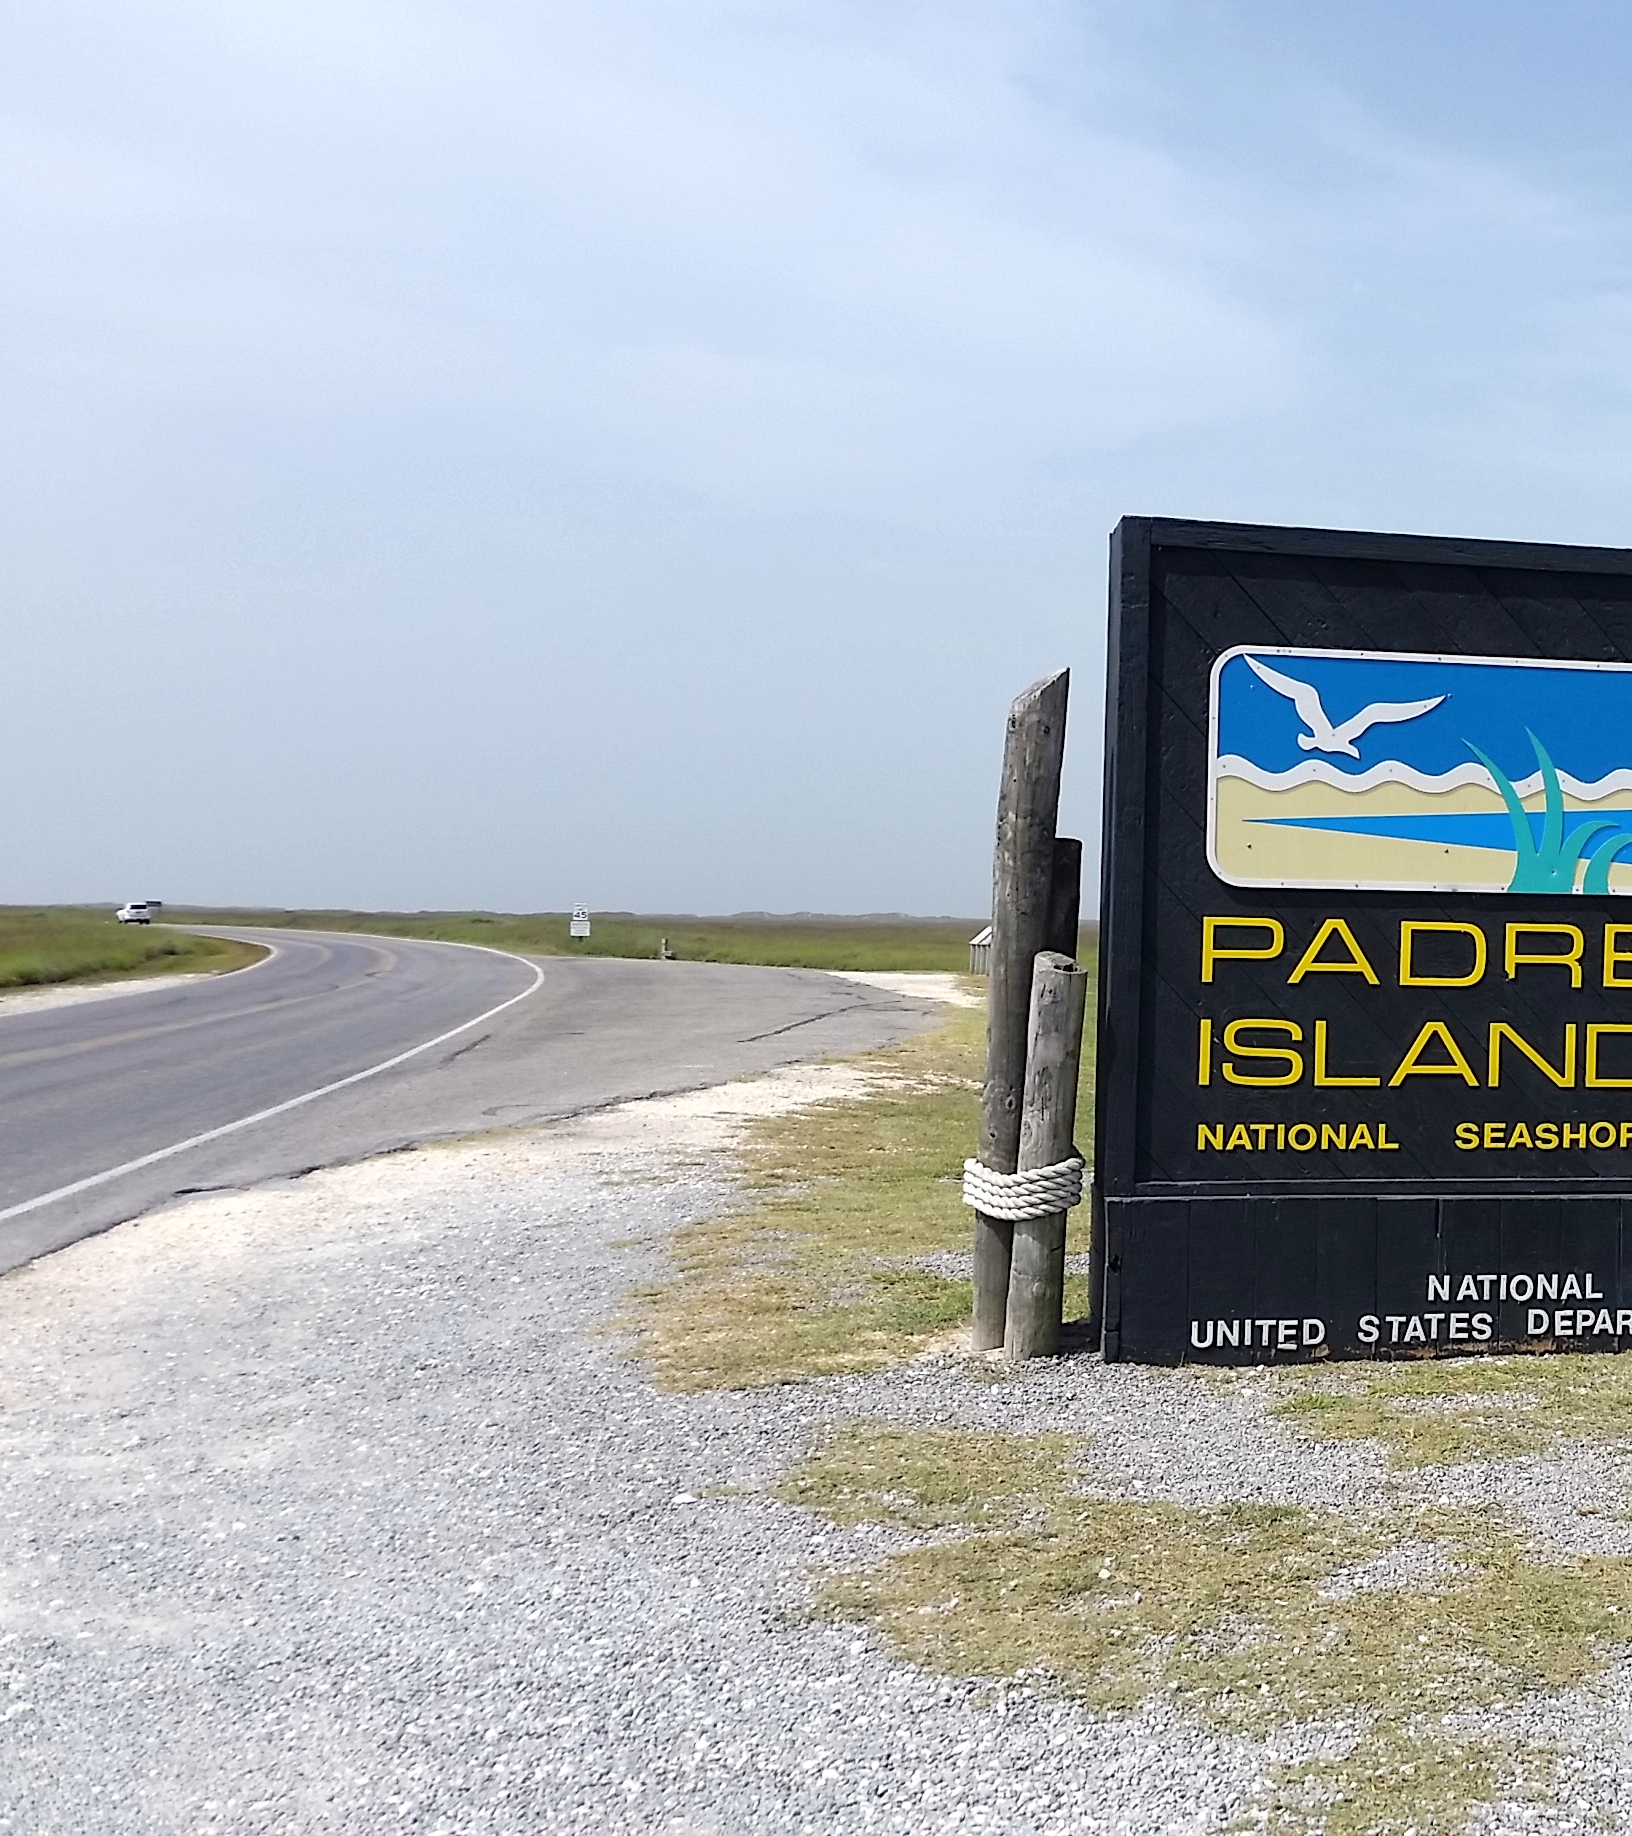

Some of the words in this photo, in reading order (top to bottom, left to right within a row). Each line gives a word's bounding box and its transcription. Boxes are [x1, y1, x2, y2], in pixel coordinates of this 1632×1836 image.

[574, 911, 587, 919] 45
[1197, 1123, 1400, 1151] NATIONAL
[1428, 1273, 1604, 1301] NATIONAL
[1191, 1318, 1326, 1349] UNITED
[1357, 1312, 1493, 1343] STATES
